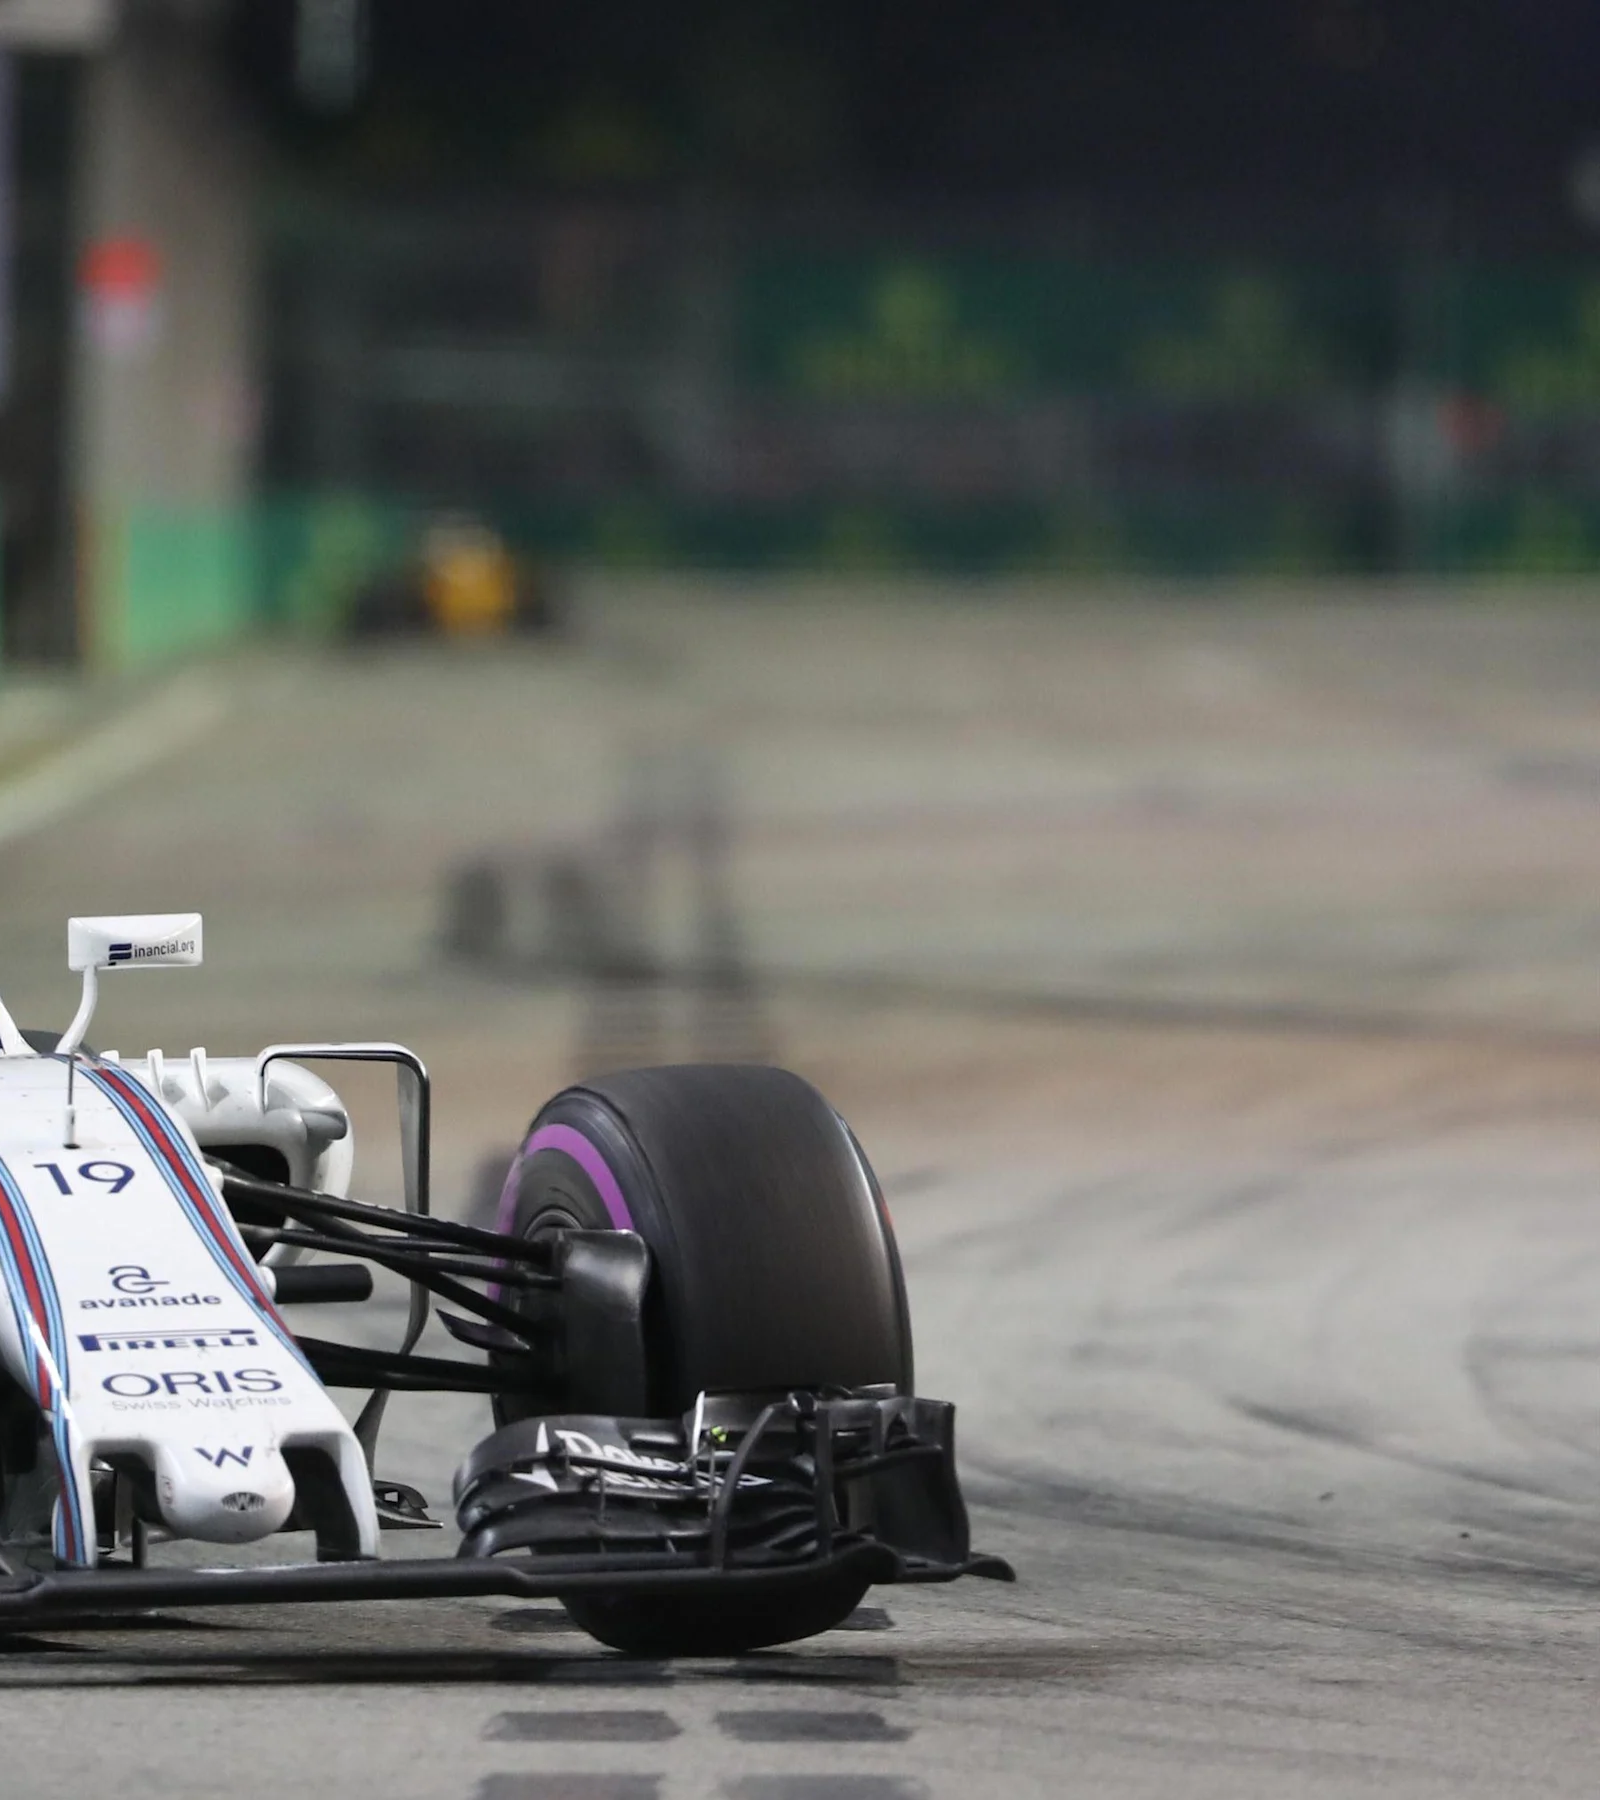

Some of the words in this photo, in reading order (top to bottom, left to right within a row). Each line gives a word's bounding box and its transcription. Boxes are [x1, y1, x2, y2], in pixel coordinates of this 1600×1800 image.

[34, 1161, 135, 1196] 19
[79, 1293, 223, 1310] avanade
[77, 1328, 260, 1353] PIRELLI
[102, 1368, 284, 1397] ORIS
[111, 1400, 181, 1412] Swiss
[188, 1396, 293, 1413] Watches
